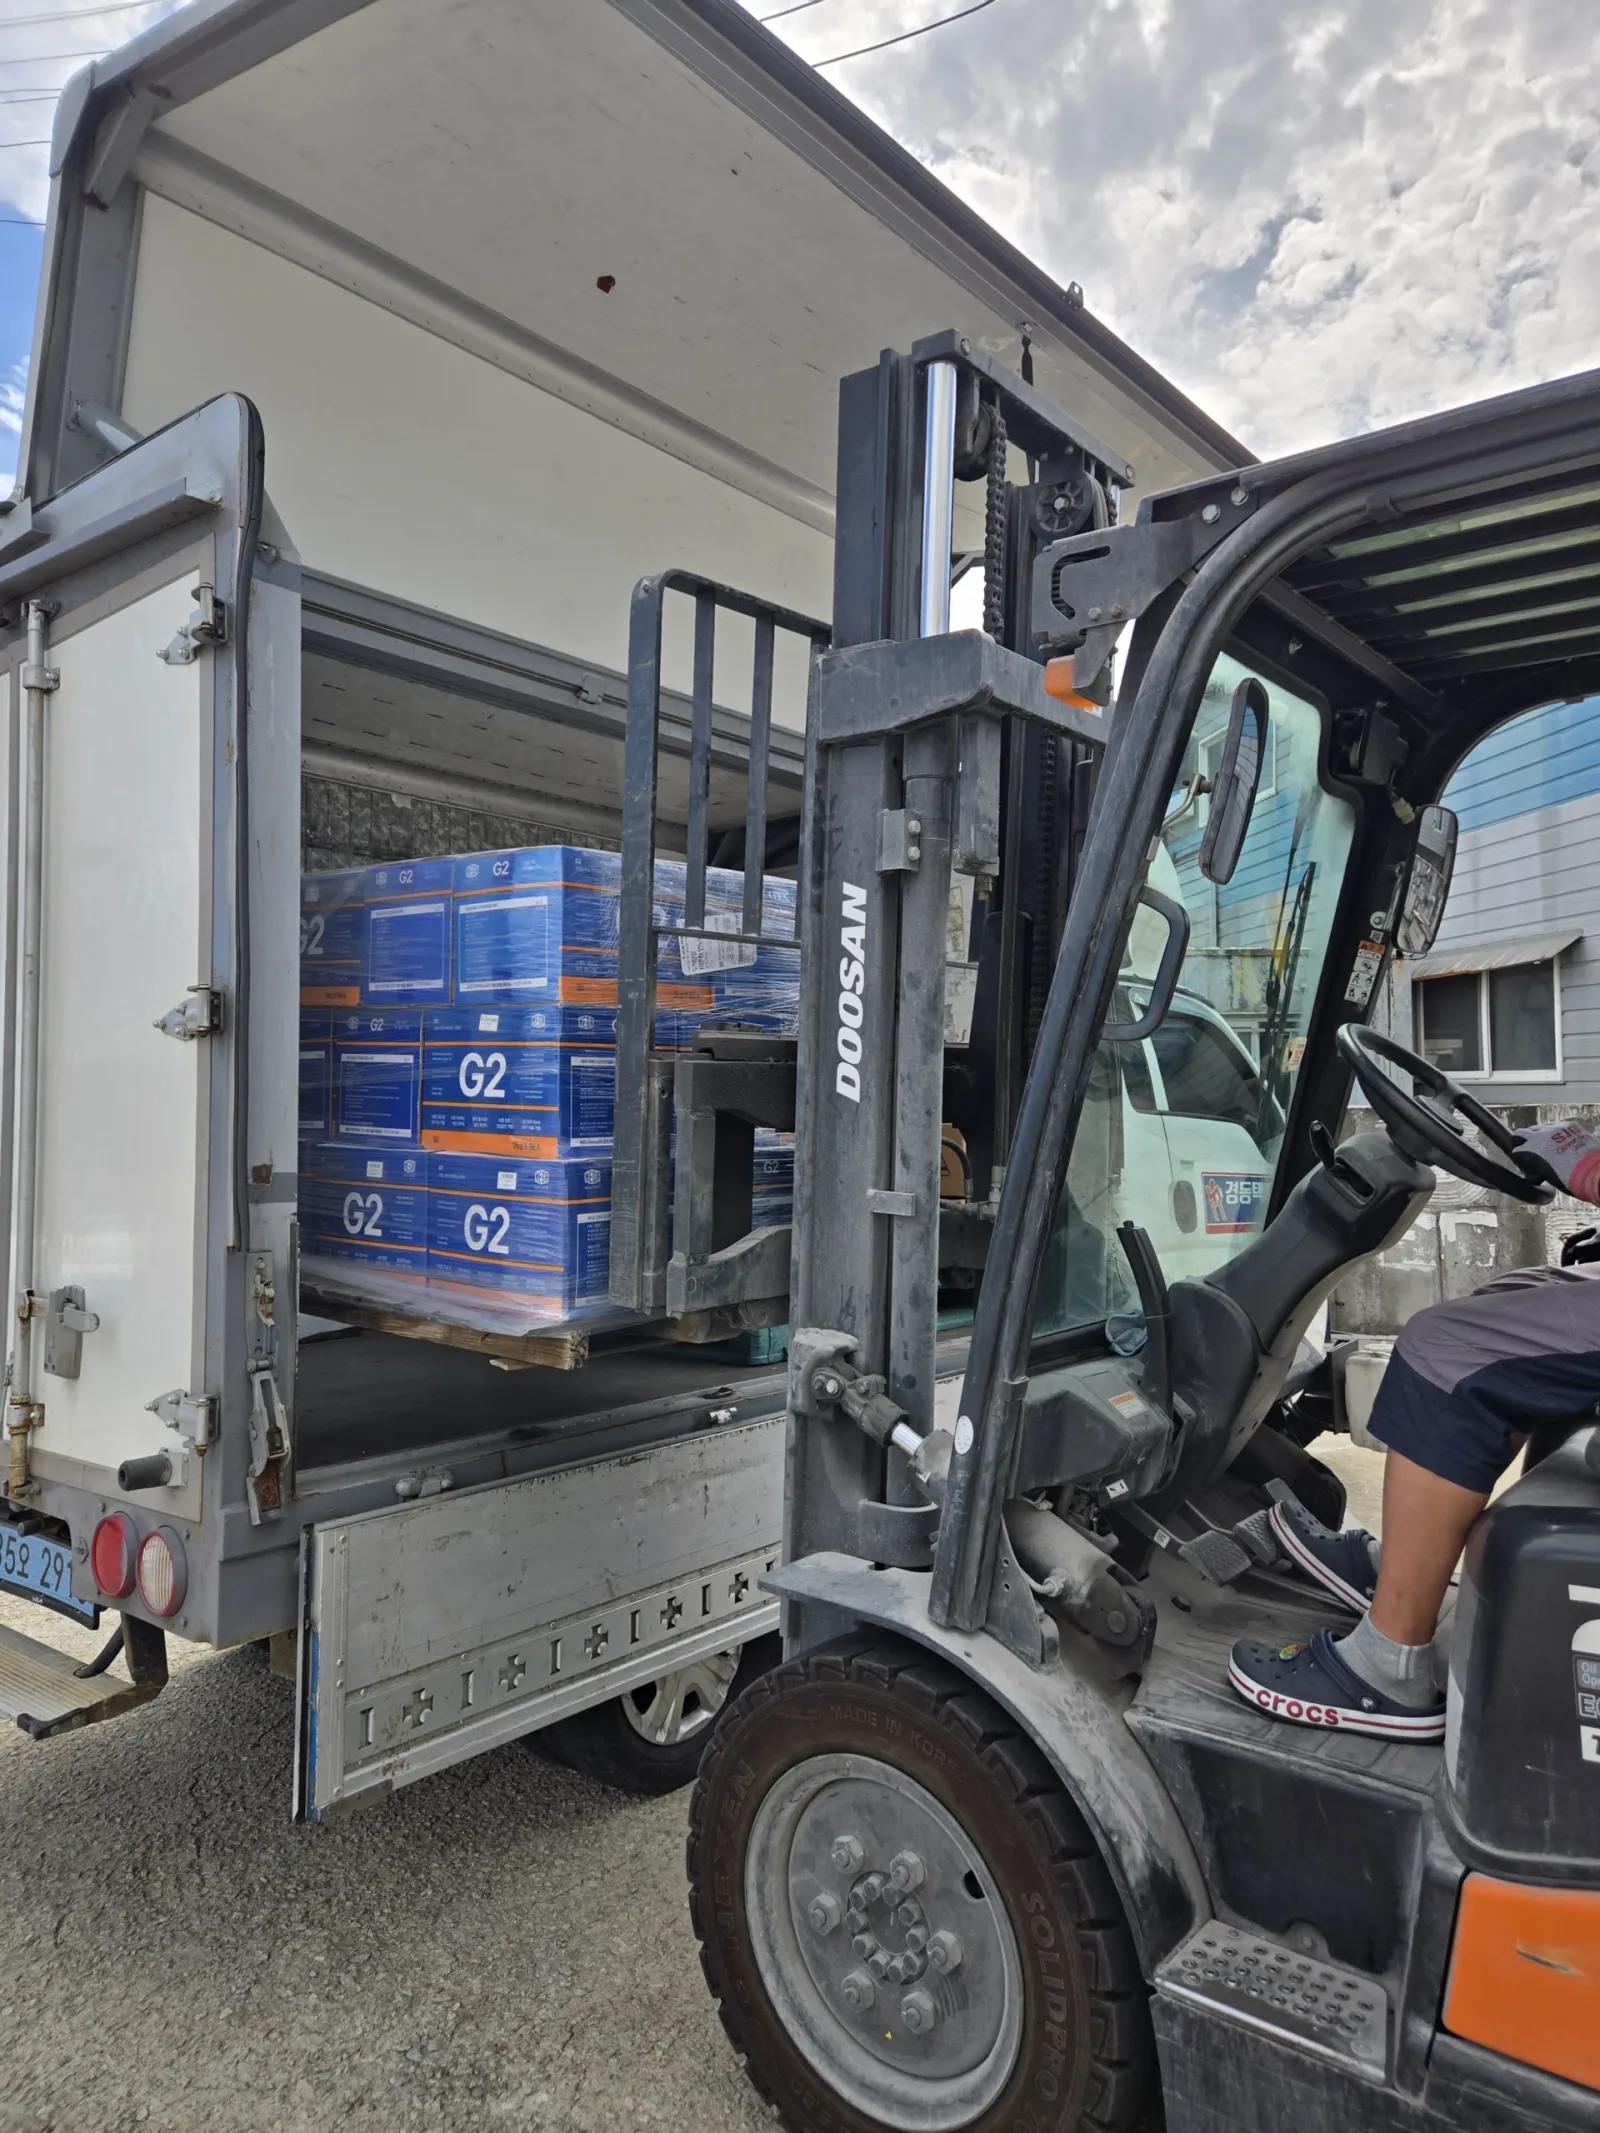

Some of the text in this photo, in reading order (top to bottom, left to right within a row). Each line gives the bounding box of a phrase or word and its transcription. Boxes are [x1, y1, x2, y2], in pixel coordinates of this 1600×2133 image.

[399, 869, 413, 884] G2
[492, 860, 510, 877] G2
[836, 881, 867, 1103] DOOSAN
[370, 1018, 384, 1032] G2
[459, 1052, 507, 1098] G2
[764, 1159, 779, 1174] G2
[343, 1191, 383, 1237] G2
[464, 1204, 510, 1255] G2
[0, 1533, 30, 1579] 5오
[1256, 1689, 1339, 1726] crocs
[1578, 1692, 1600, 1719] E
[829, 1704, 967, 1786] MADE IN KOREA
[714, 1757, 757, 1952] NEXEN
[1020, 1891, 1068, 2103] SOLIDPRO
